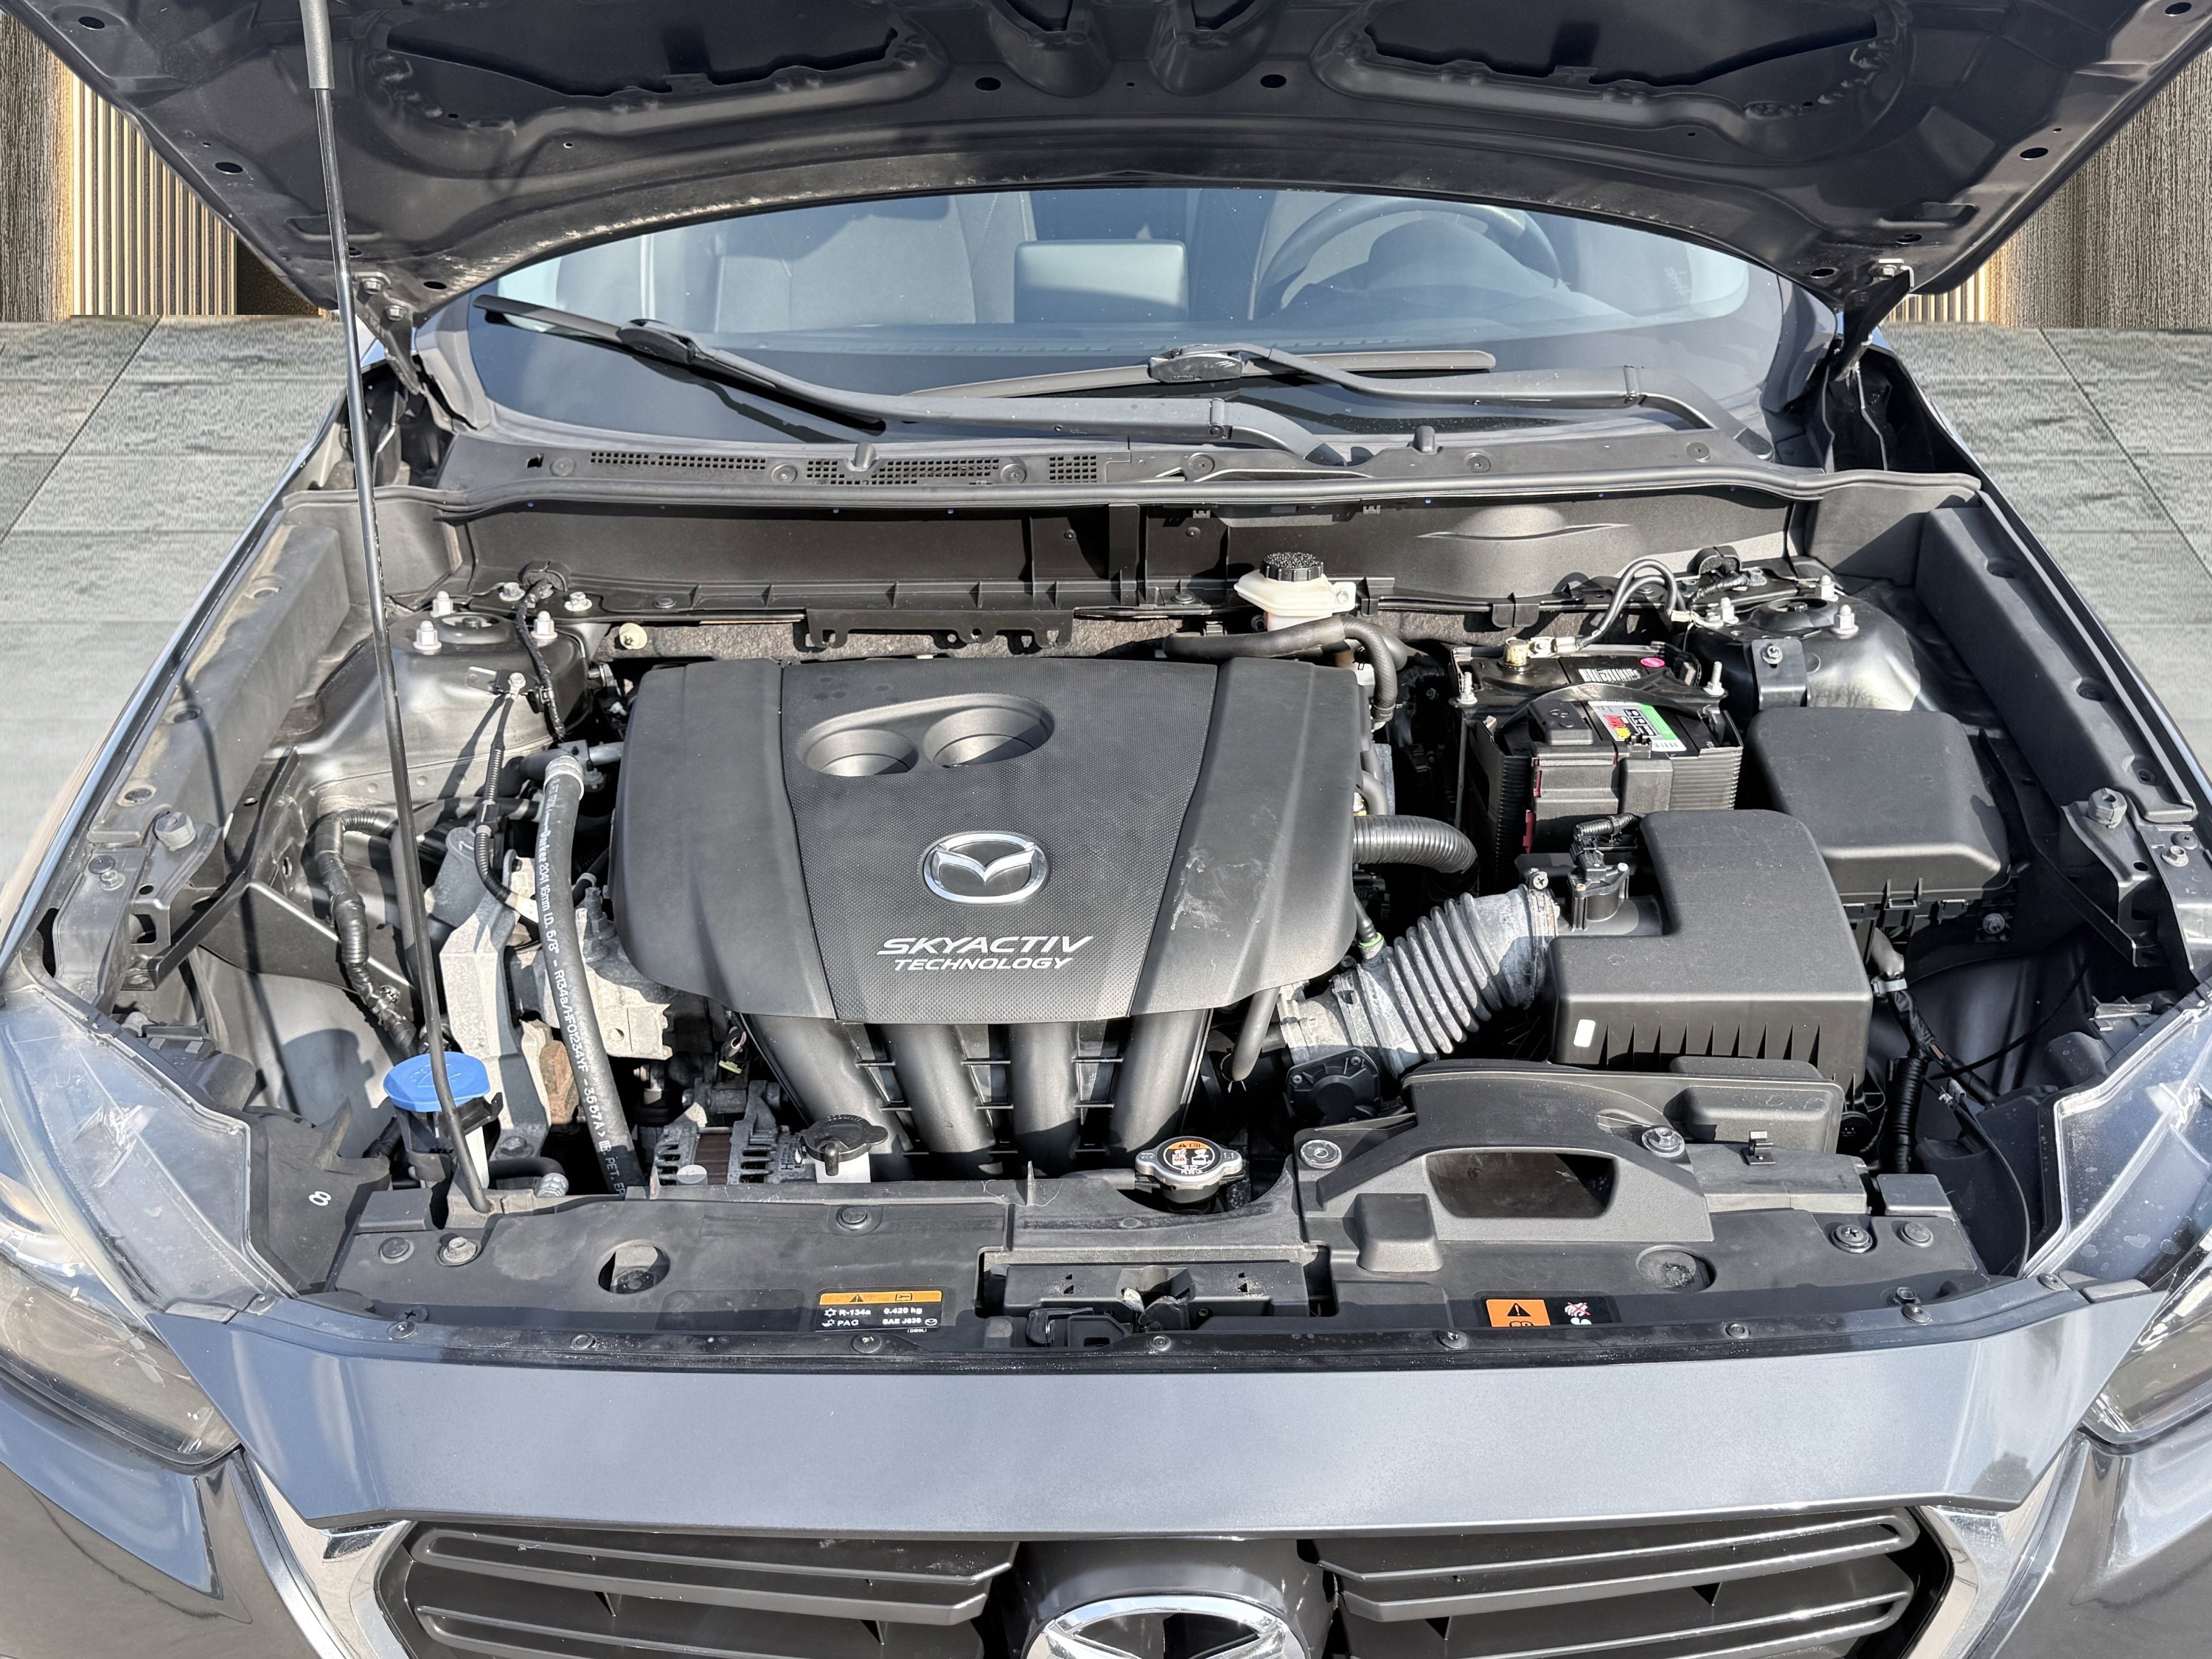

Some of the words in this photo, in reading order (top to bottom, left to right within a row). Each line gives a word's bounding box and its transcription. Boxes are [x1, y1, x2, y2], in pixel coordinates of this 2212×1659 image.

[540, 884, 551, 912] 16mm
[876, 935, 1094, 956] SKYACTIV
[894, 957, 1074, 972] TECHNOLOGY
[911, 1307, 923, 1315] kg
